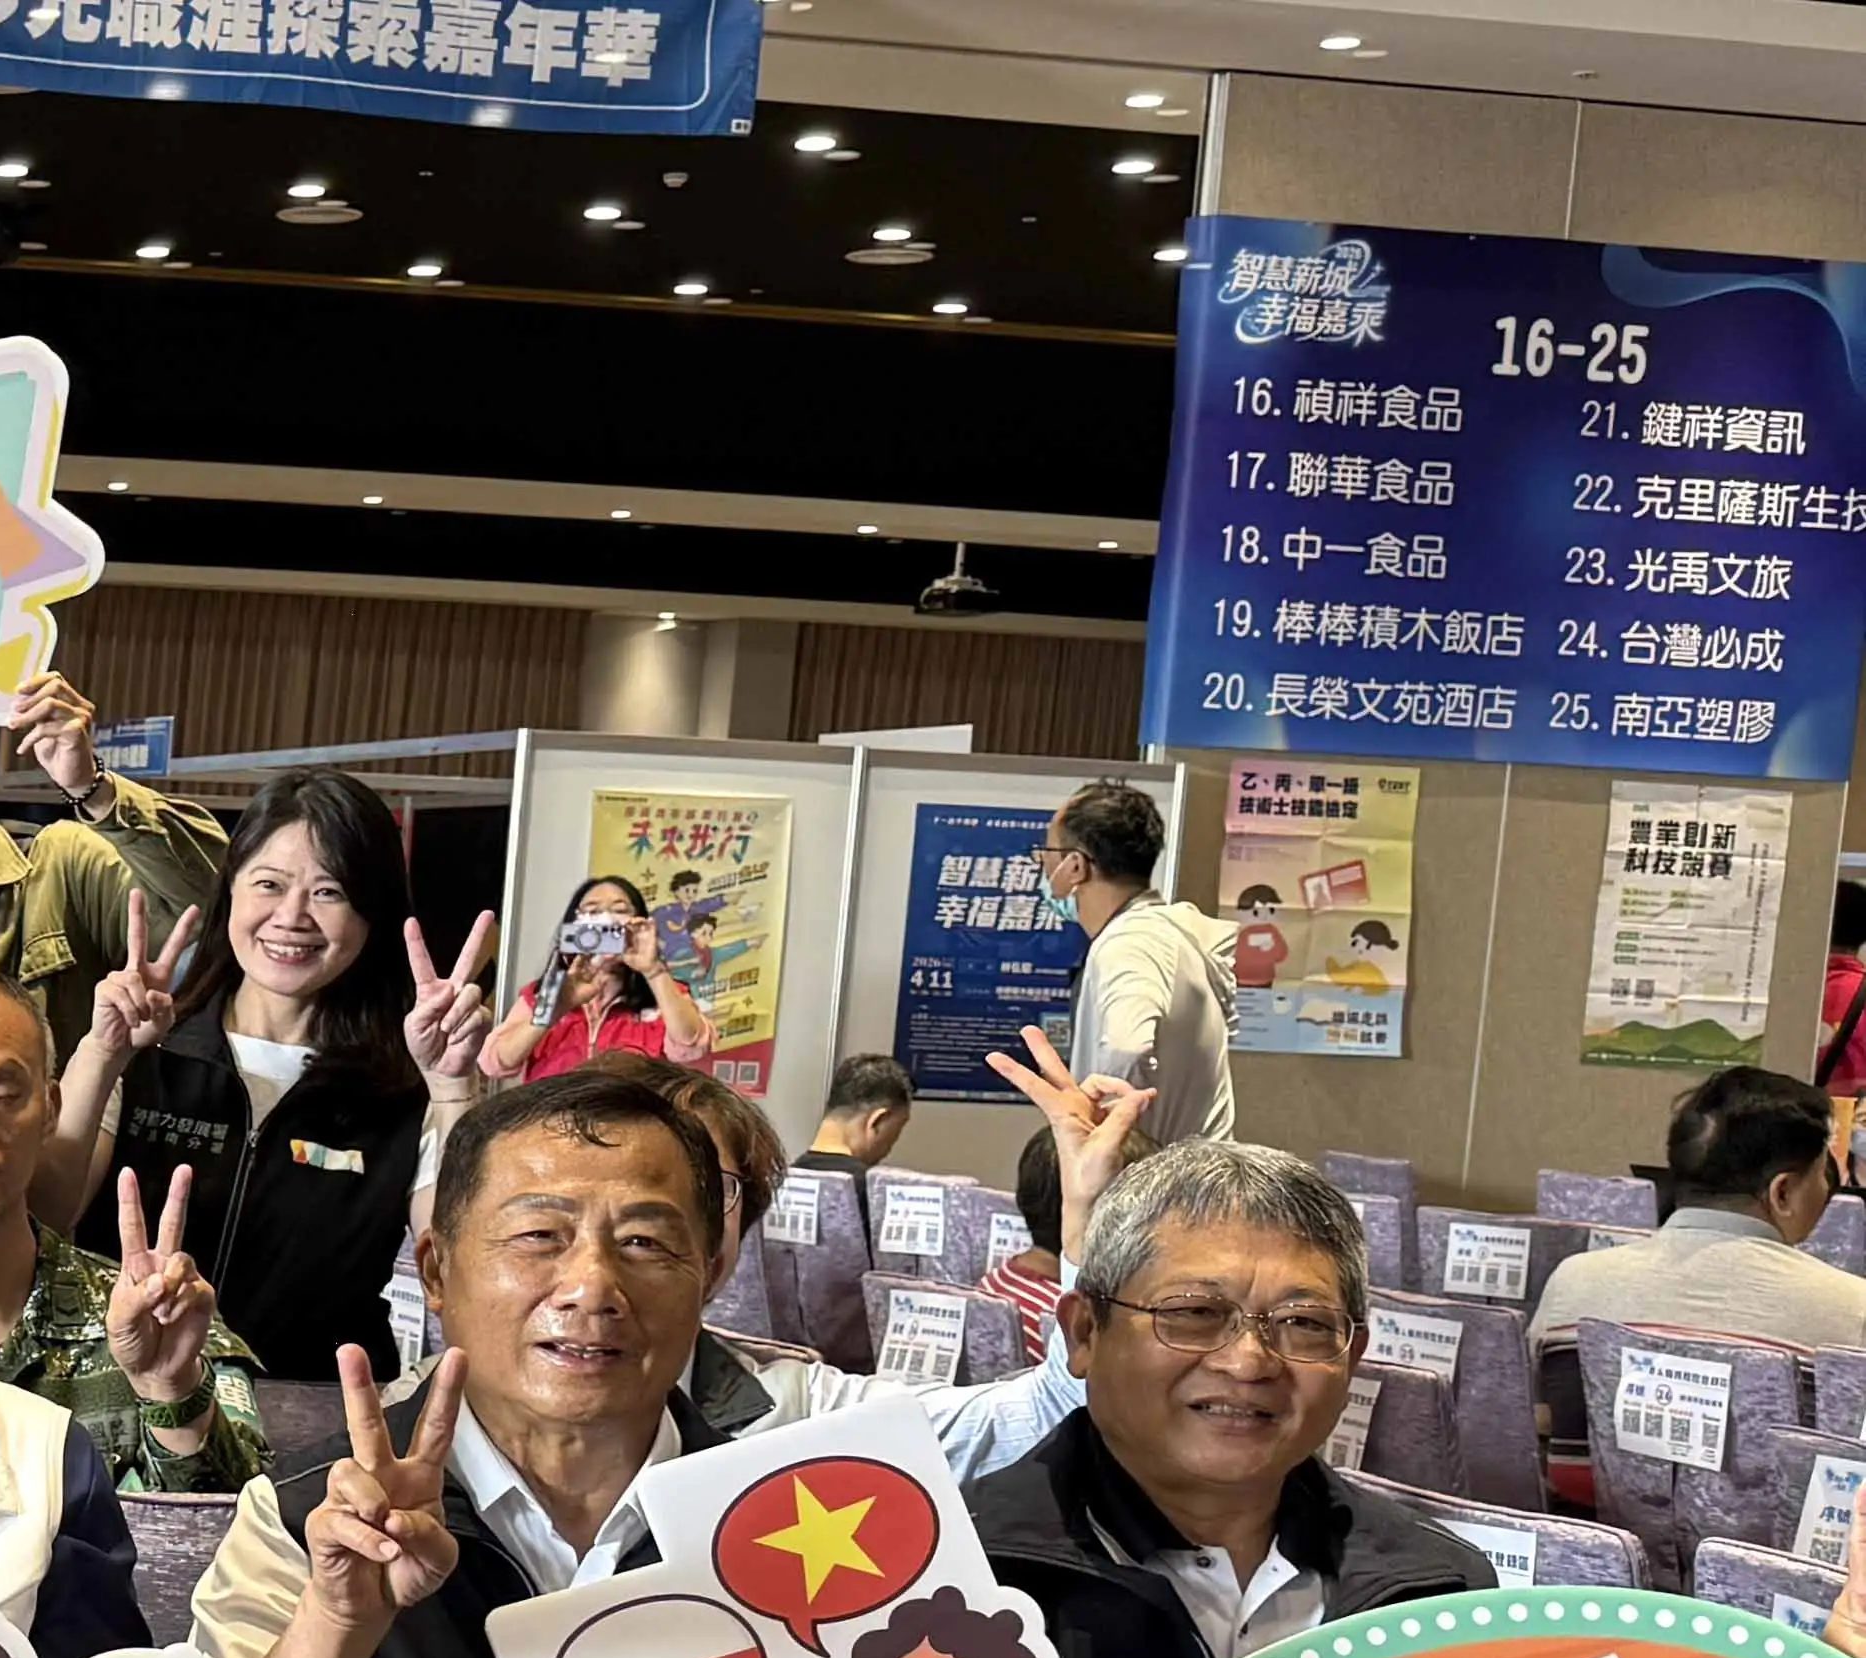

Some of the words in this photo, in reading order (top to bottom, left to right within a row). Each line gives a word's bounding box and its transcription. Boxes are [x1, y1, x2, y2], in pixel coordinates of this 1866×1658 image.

[1491, 316, 1650, 385] 16-25
[1232, 377, 1282, 417] 16.
[1581, 402, 1630, 441] 21.
[1226, 452, 1275, 492] 17.
[1285, 452, 1454, 507] 聯華食品
[1572, 475, 1621, 515] 22.
[1221, 525, 1270, 565] 18.
[1282, 528, 1447, 579] 中一食品
[1564, 547, 1615, 587] 23.
[1624, 548, 1792, 601] 光禹文旅
[1212, 599, 1260, 640] 19.
[1273, 599, 1525, 658] 棒棒積木飯店
[1558, 621, 1608, 660] 24.
[1620, 622, 1784, 672] 台灣必成
[1203, 673, 1254, 713] 20.
[1265, 673, 1516, 730] 長榮文苑酒店
[1550, 693, 1600, 733] 25.
[1610, 693, 1776, 745] 南亞塑膠
[938, 854, 1045, 893] 智慧薪
